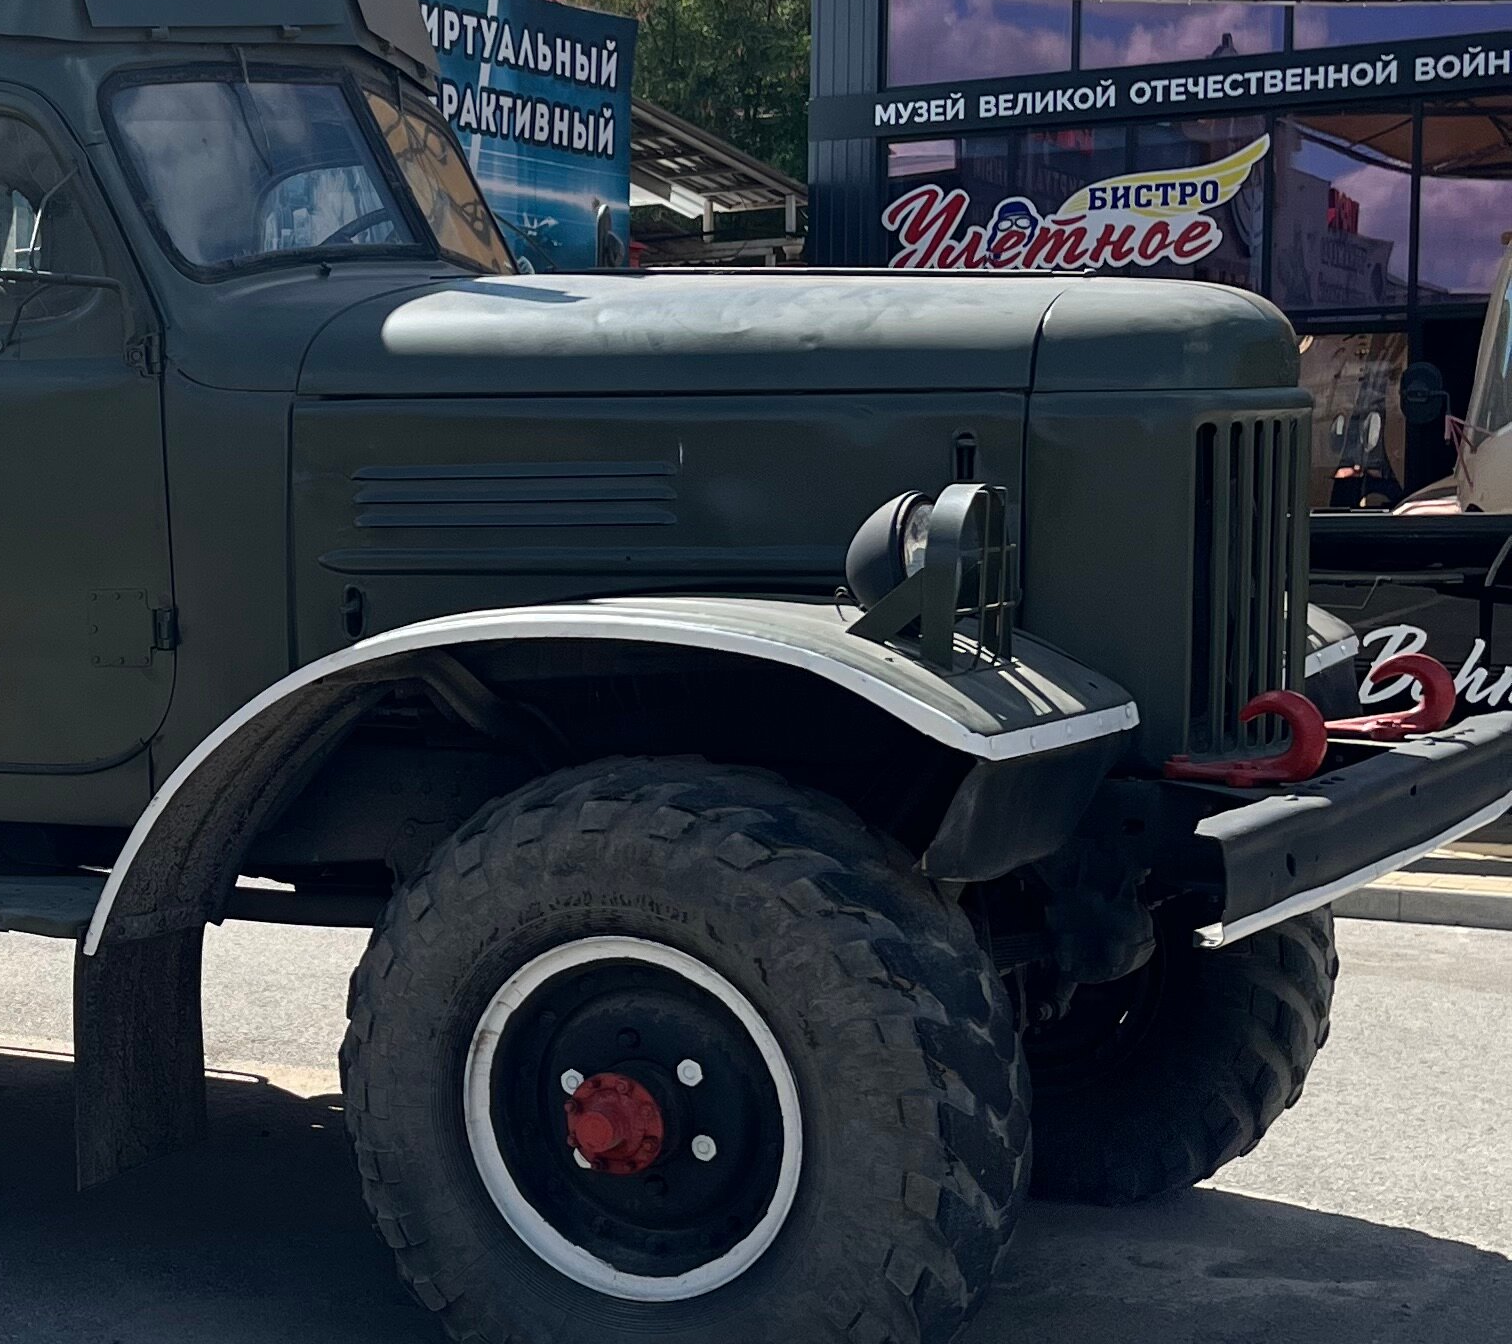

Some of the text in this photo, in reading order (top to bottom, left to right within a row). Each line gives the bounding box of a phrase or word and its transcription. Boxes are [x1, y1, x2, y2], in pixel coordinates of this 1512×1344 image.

[419, 1, 619, 90] ИРТУАЛЬНЫЙ
[428, 82, 616, 156] РАКТИВНЫЙ
[874, 45, 1511, 126] МУЗЕЙ ВЕЛИКОЙ ОТЕЧЕСТВЕННОЙ ВОЙН
[1088, 180, 1220, 212] БИСТРО
